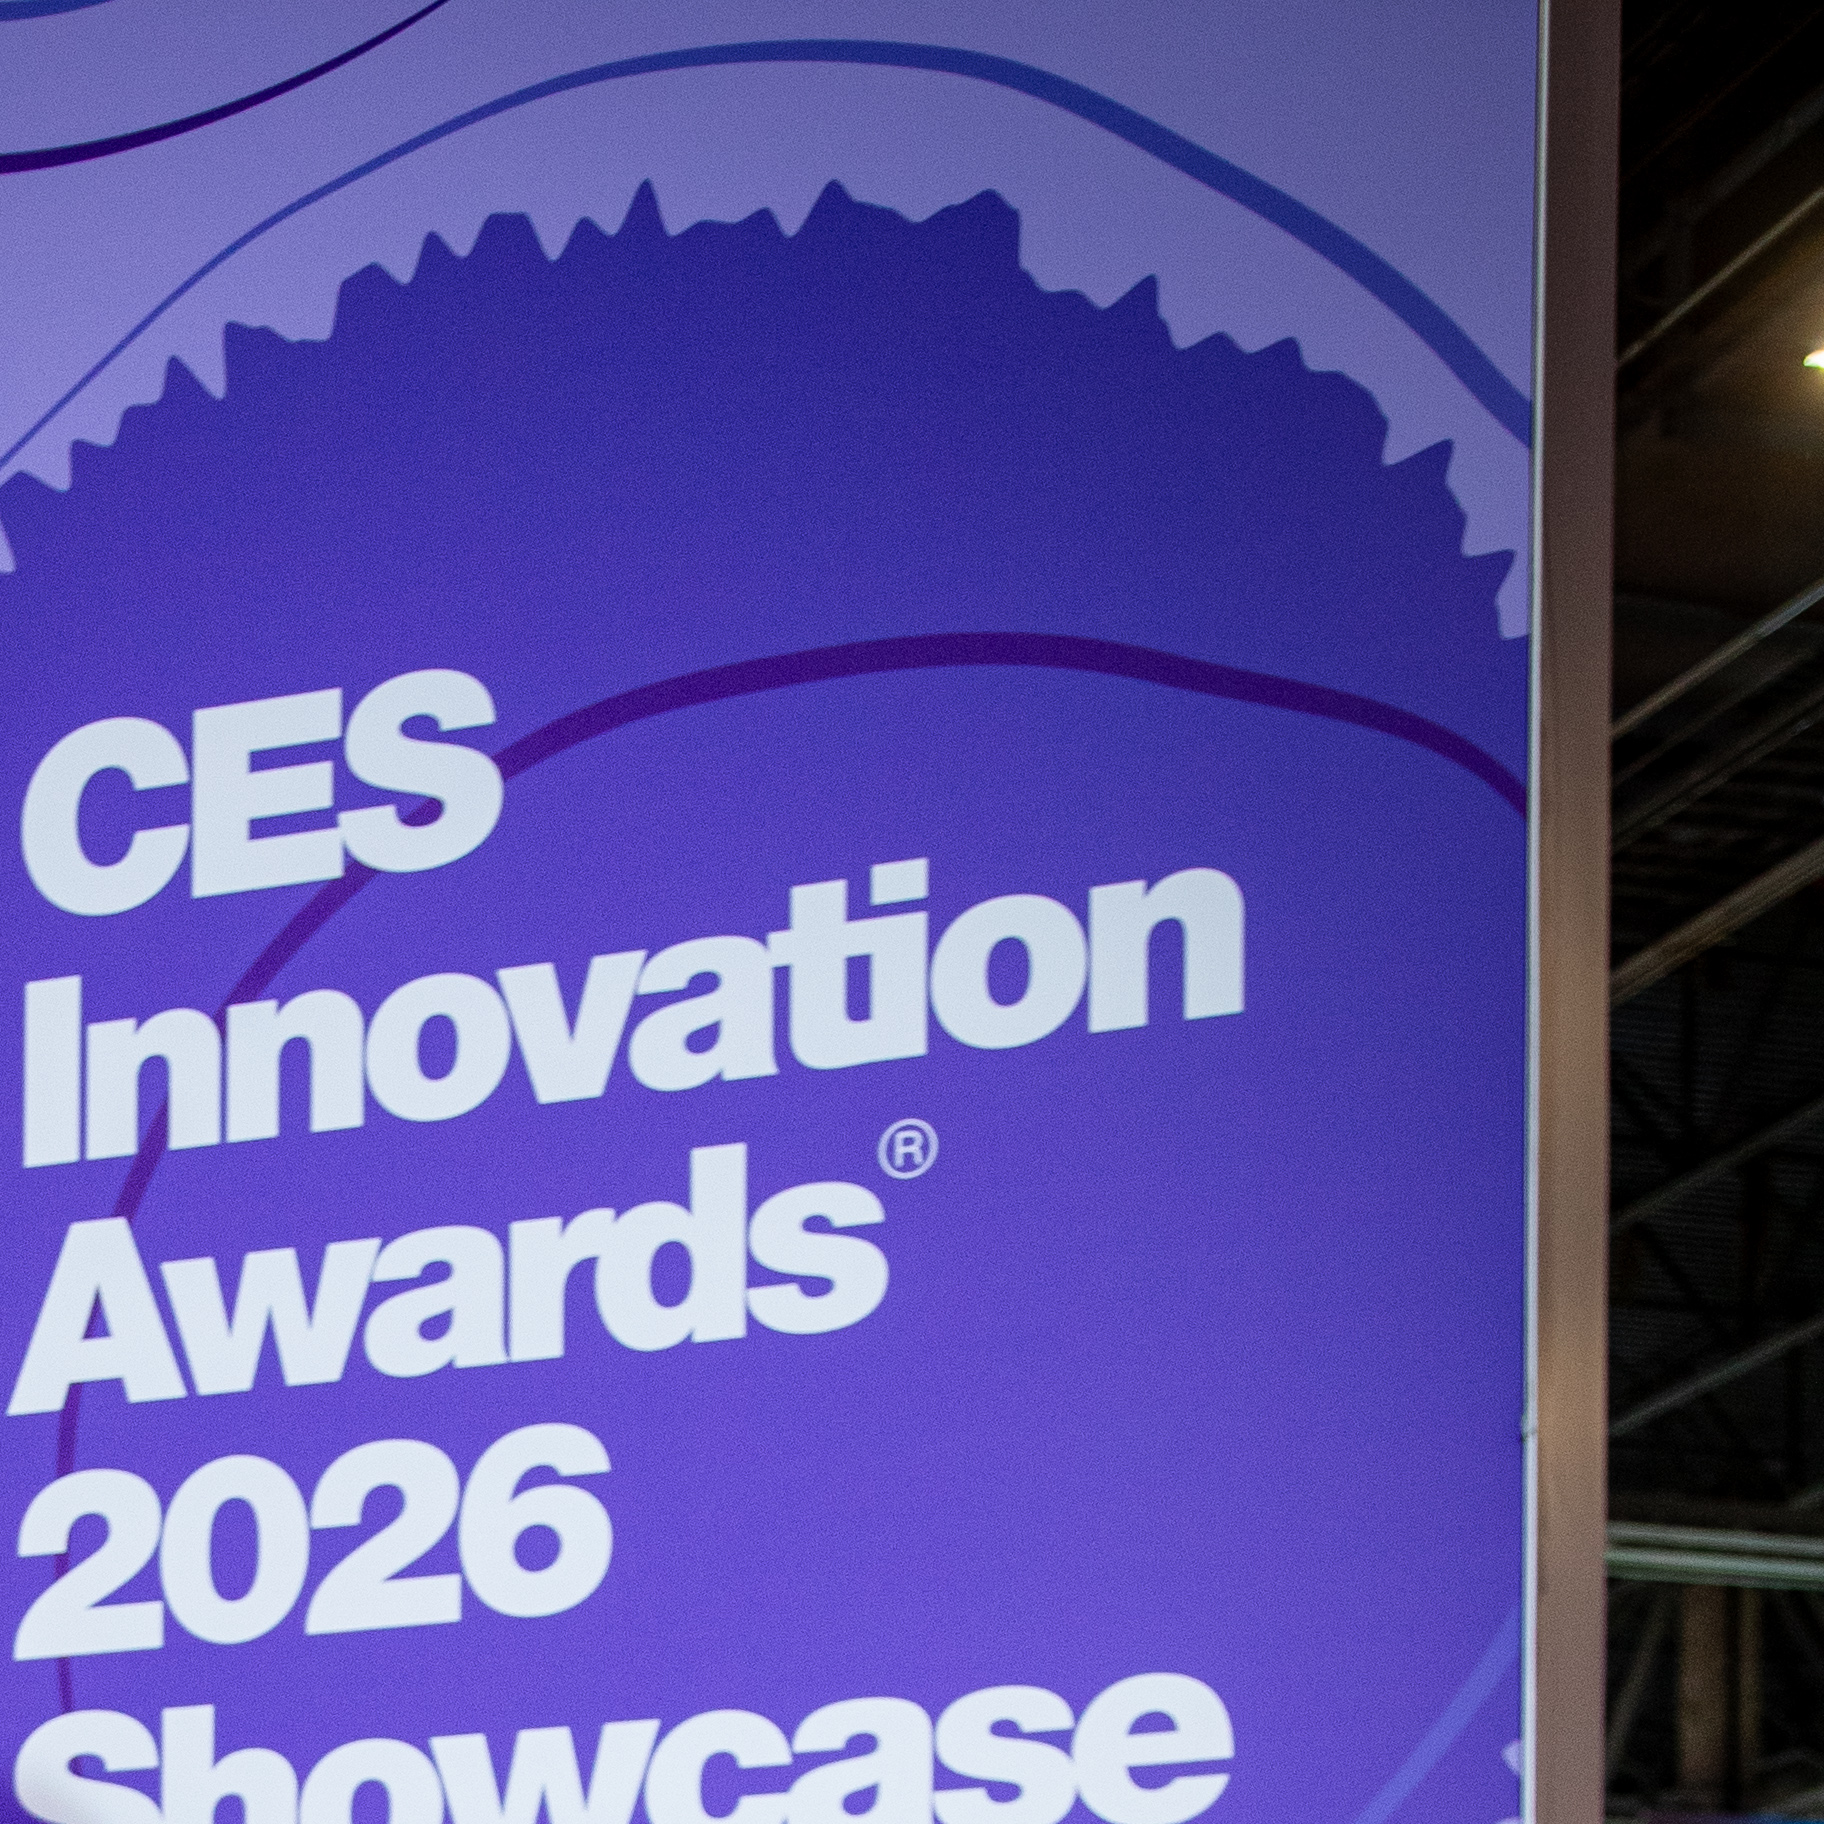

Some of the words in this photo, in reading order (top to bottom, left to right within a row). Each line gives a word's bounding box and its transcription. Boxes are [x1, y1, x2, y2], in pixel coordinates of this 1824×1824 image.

[21, 668, 504, 917] CES
[22, 857, 1246, 1169] Innovation
[13, 1422, 614, 1662] 2026
